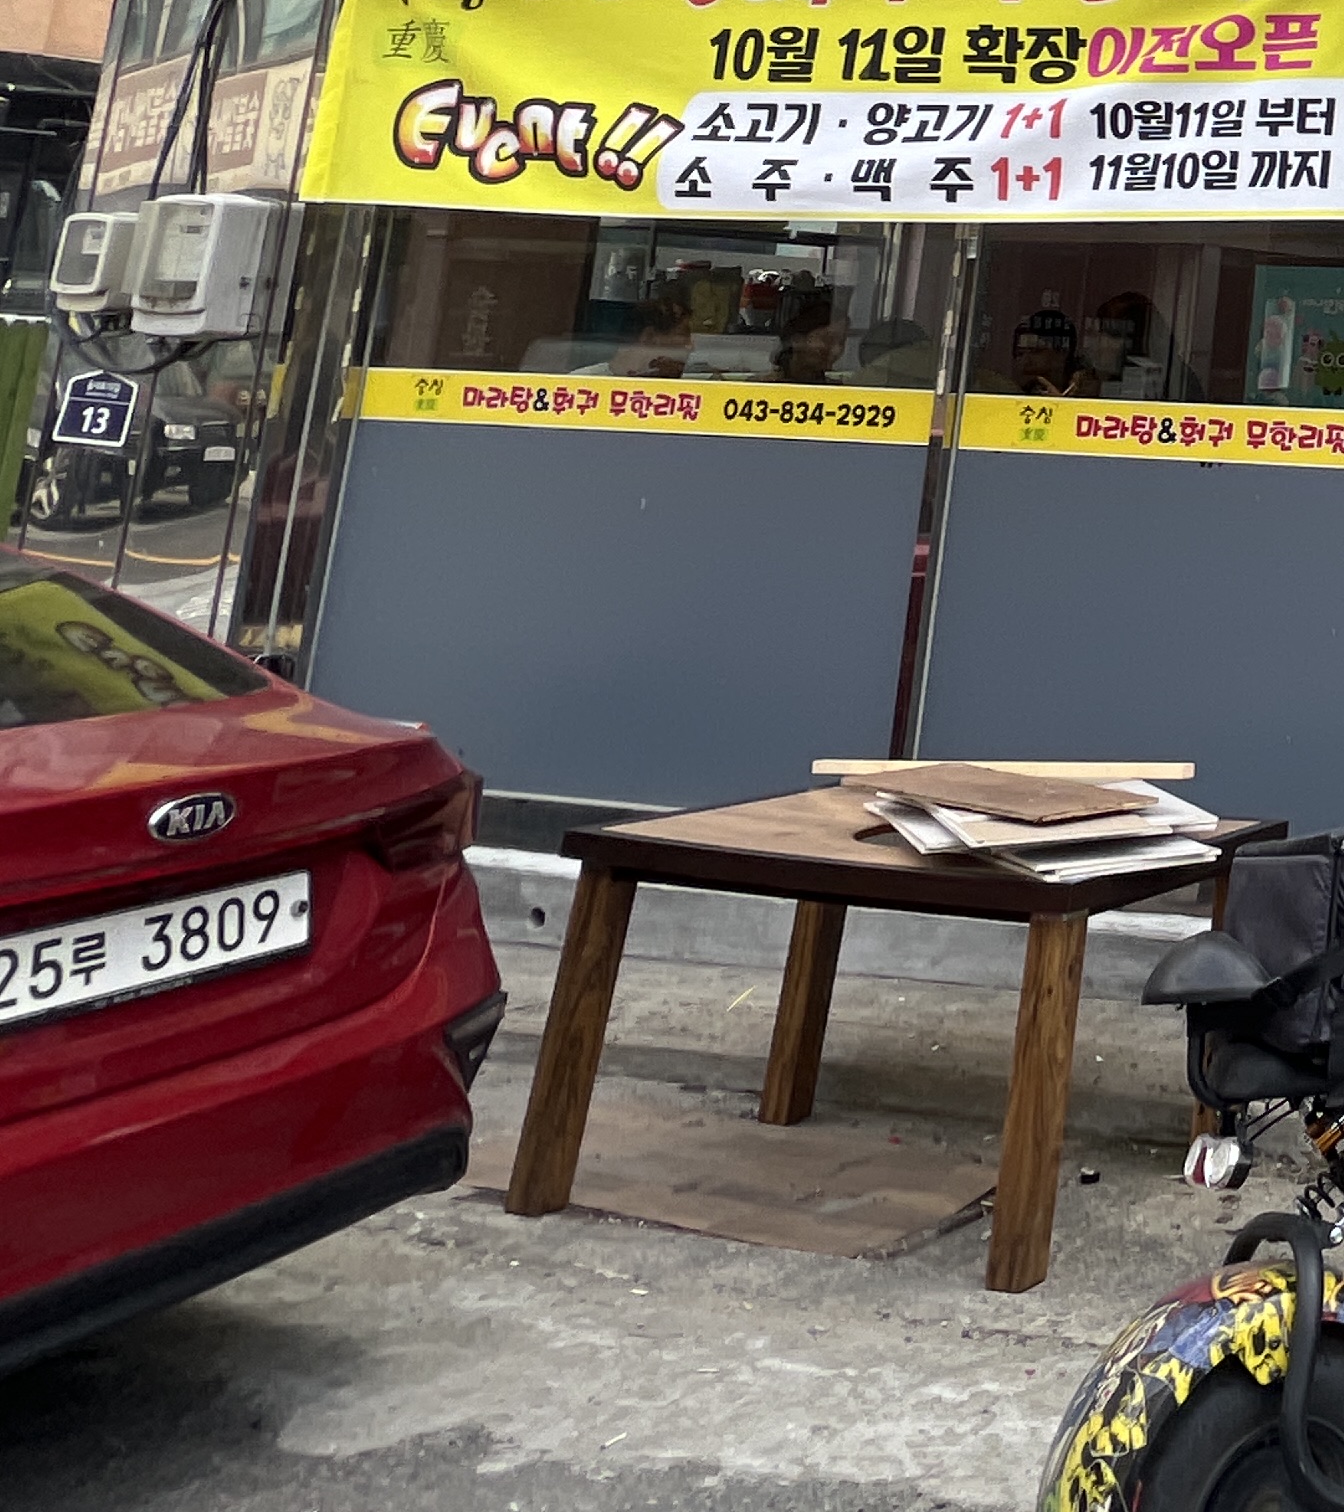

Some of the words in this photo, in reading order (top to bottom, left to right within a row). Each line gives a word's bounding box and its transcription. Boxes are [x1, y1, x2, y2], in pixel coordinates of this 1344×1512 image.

[382, 18, 451, 65] 重慶
[709, 25, 820, 84] 10월
[837, 24, 945, 84] 11일
[691, 101, 822, 145] 소고기
[863, 101, 994, 146] 양고기
[999, 97, 1069, 141] 1+1
[1090, 98, 1247, 141] 10월11일
[1255, 96, 1337, 139] 부터
[990, 155, 1064, 202] 1+1
[1089, 148, 1241, 192] 11월10일
[1249, 148, 1332, 191] 까지
[81, 406, 110, 434] 13
[609, 390, 702, 424] 무한리필
[723, 398, 897, 429] 043-834-2929
[166, 800, 226, 837] KIA
[141, 889, 281, 972] 3809
